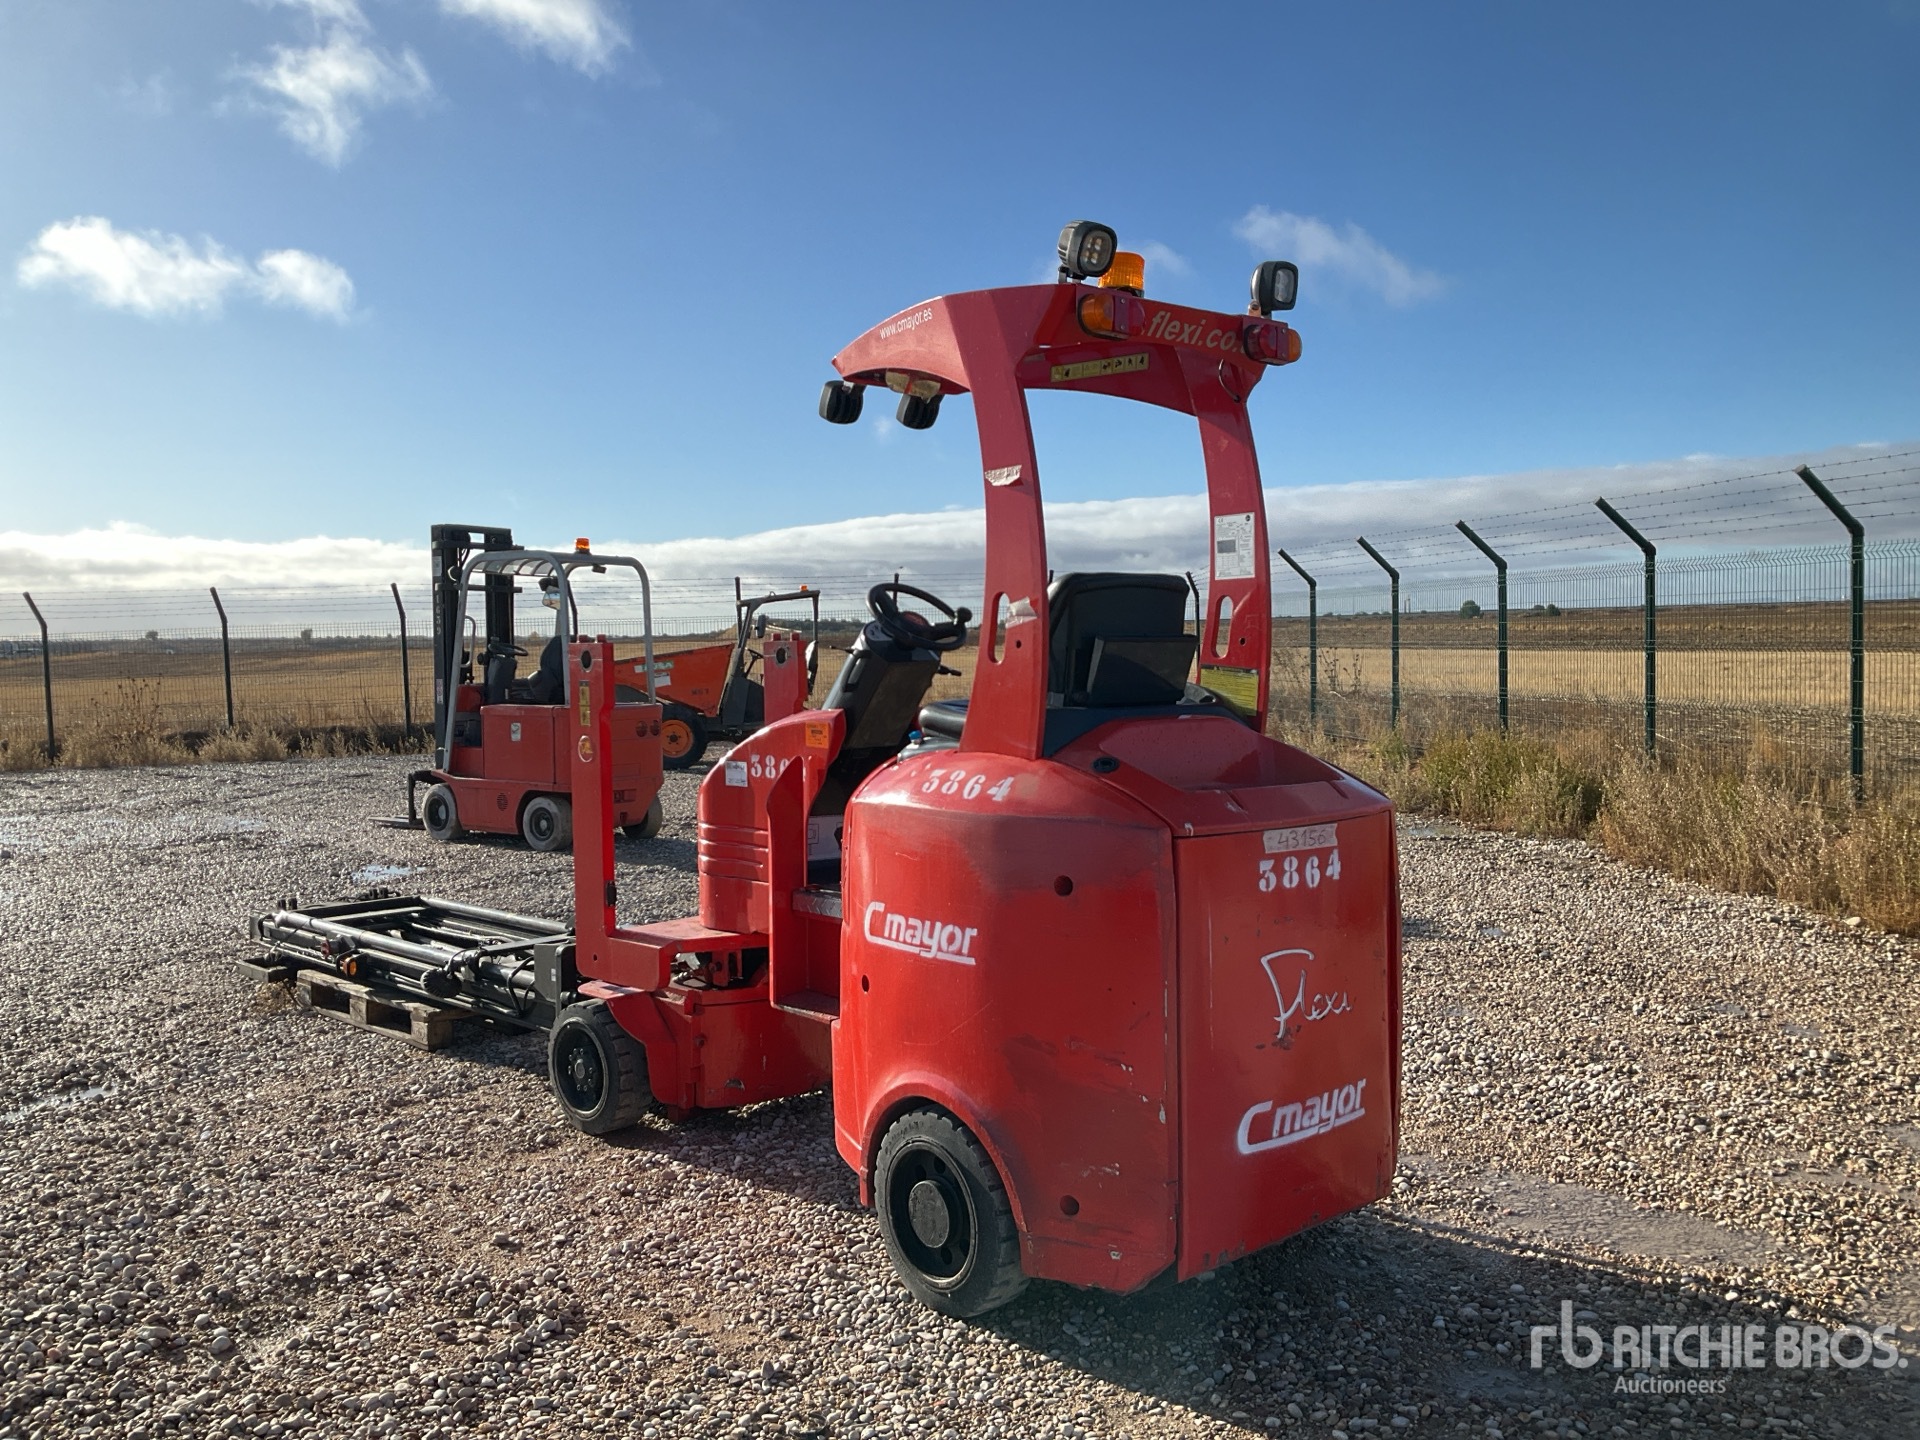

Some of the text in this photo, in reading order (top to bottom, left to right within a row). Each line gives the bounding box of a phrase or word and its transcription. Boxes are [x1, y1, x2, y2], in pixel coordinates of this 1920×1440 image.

[879, 307, 933, 340] www.cmayor.es
[921, 768, 1015, 802] 3864
[1277, 829, 1326, 849] 43156
[1258, 848, 1341, 892] 3864
[863, 900, 978, 966] Cmayor
[1237, 1078, 1367, 1155] Cmayor
